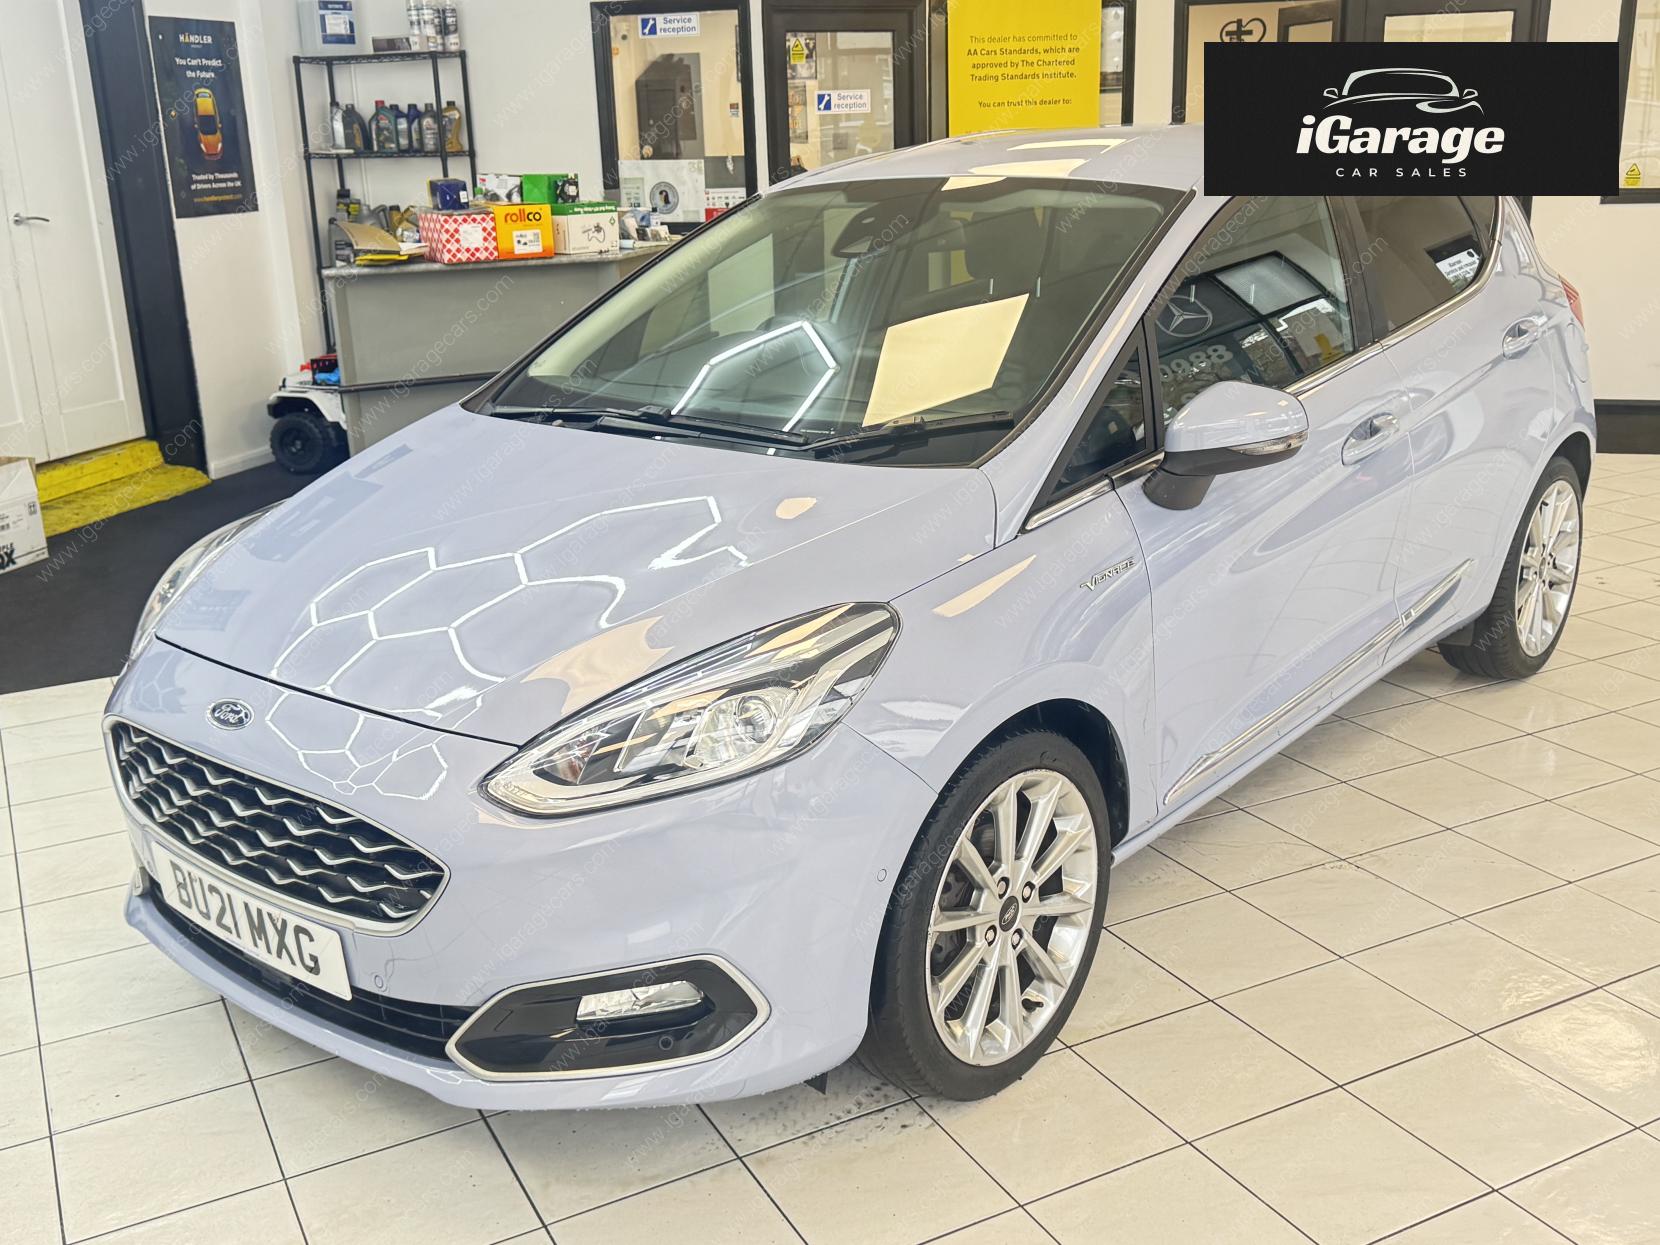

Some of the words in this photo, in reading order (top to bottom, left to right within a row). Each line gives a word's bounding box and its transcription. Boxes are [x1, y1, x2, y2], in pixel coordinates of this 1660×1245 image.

[663, 15, 692, 26] Service
[659, 24, 697, 35] reception
[969, 35, 985, 44] This
[986, 34, 1011, 43] dealer
[1012, 33, 1026, 43] has
[1027, 33, 1068, 42] committed
[1070, 33, 1078, 41] to
[967, 48, 978, 56] AA
[980, 47, 998, 56] Cars
[1043, 46, 1066, 54] which
[1068, 46, 1080, 54] are
[174, 57, 186, 66] You
[971, 60, 1008, 70] approved
[1010, 59, 1019, 69] by
[1021, 59, 1035, 67] The
[1036, 58, 1075, 67] Chartered
[970, 73, 999, 83] Trading
[1001, 72, 1040, 81] Standards
[837, 92, 864, 101] Service
[833, 101, 867, 110] reception
[978, 100, 991, 109] You
[1007, 99, 1023, 107] trust
[1025, 98, 1037, 107] this
[1039, 97, 1061, 106] dealer
[504, 208, 542, 223] rollco
[169, 858, 242, 940] BU21
[244, 900, 321, 977] MXG
